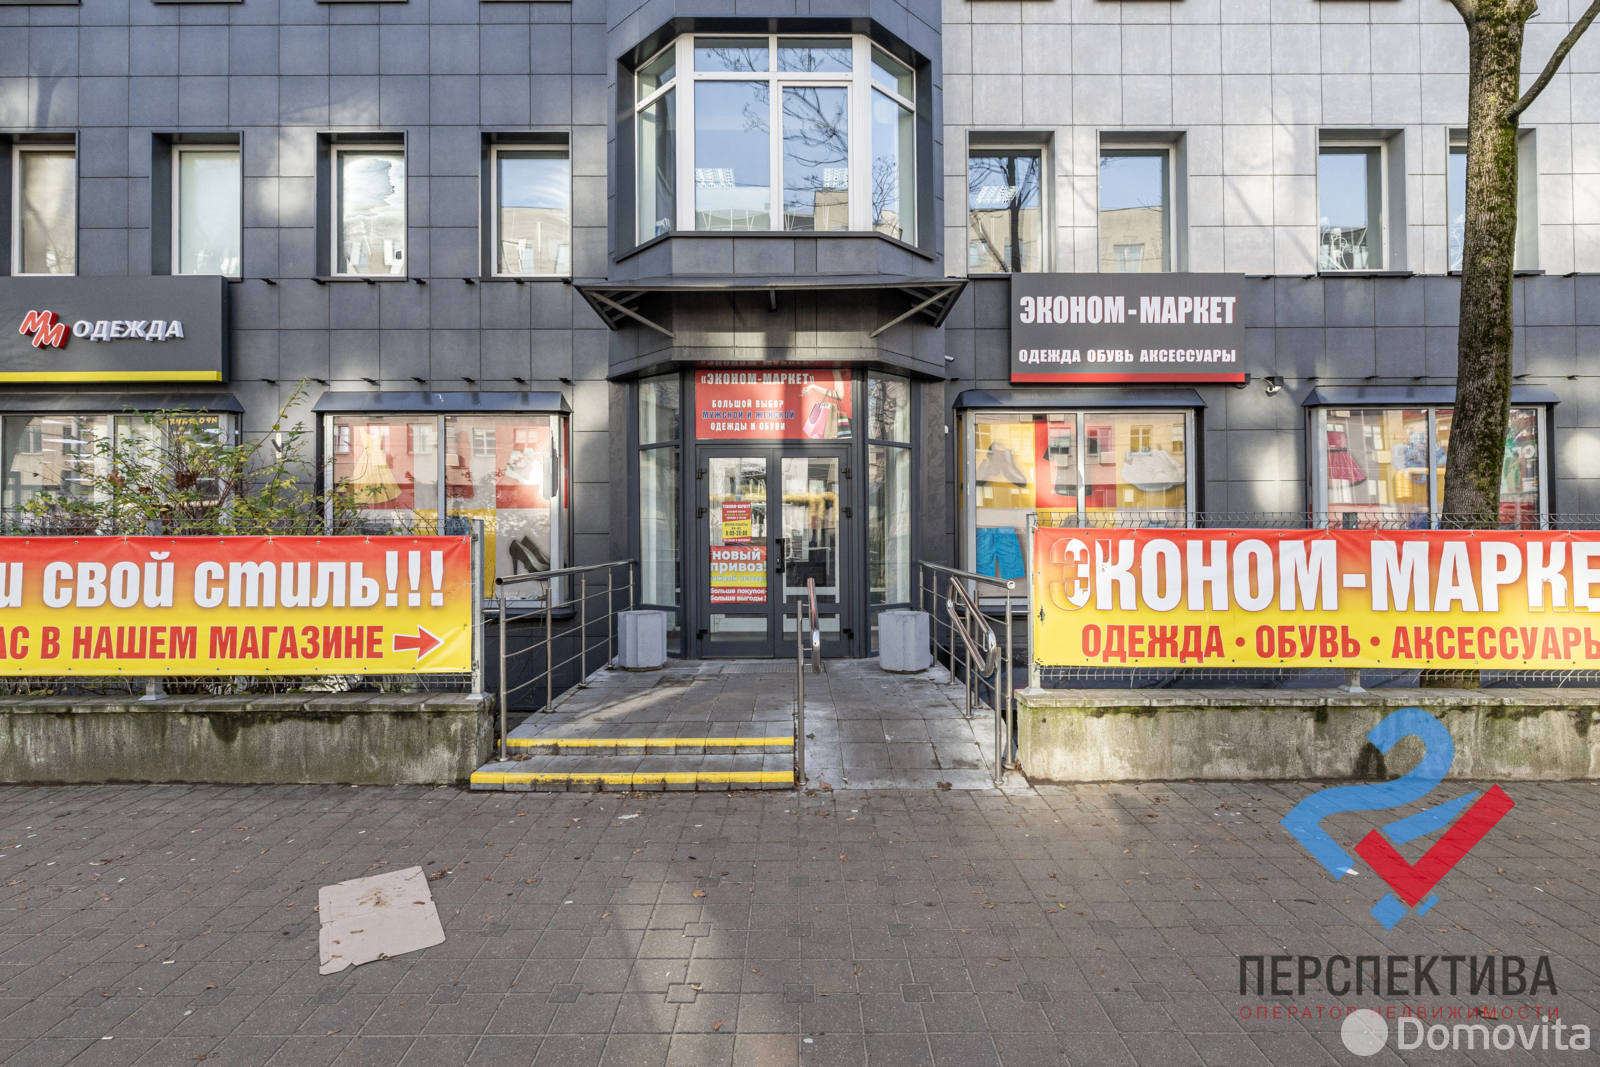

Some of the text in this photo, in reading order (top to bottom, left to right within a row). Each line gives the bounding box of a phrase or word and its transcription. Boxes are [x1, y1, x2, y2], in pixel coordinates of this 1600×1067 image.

[1019, 295, 1237, 324] ЭКОНОМ-МАРКЕТ
[72, 320, 184, 342] ОДЕЖДА
[1018, 349, 1236, 364] ОДЕЖДА ОБУВЬ АКСЕССУАРЫ
[702, 410, 795, 419] МУЖСКОЙ И ЖЕНСКОЙ
[712, 399, 784, 408] БОЛЬШОЙ ВЫБОР
[710, 422, 786, 432] ОДЕЖДЫ И ОБУВИ
[43, 550, 175, 608] свой
[194, 550, 445, 608] стиль!!!
[41, 626, 61, 660] В
[72, 625, 198, 660] НАШЕМ
[209, 625, 384, 660] МАГАЗИНЕ
[1081, 623, 1226, 664] ОДЕЖДА
[1255, 624, 1361, 659] ОБУВЬ
